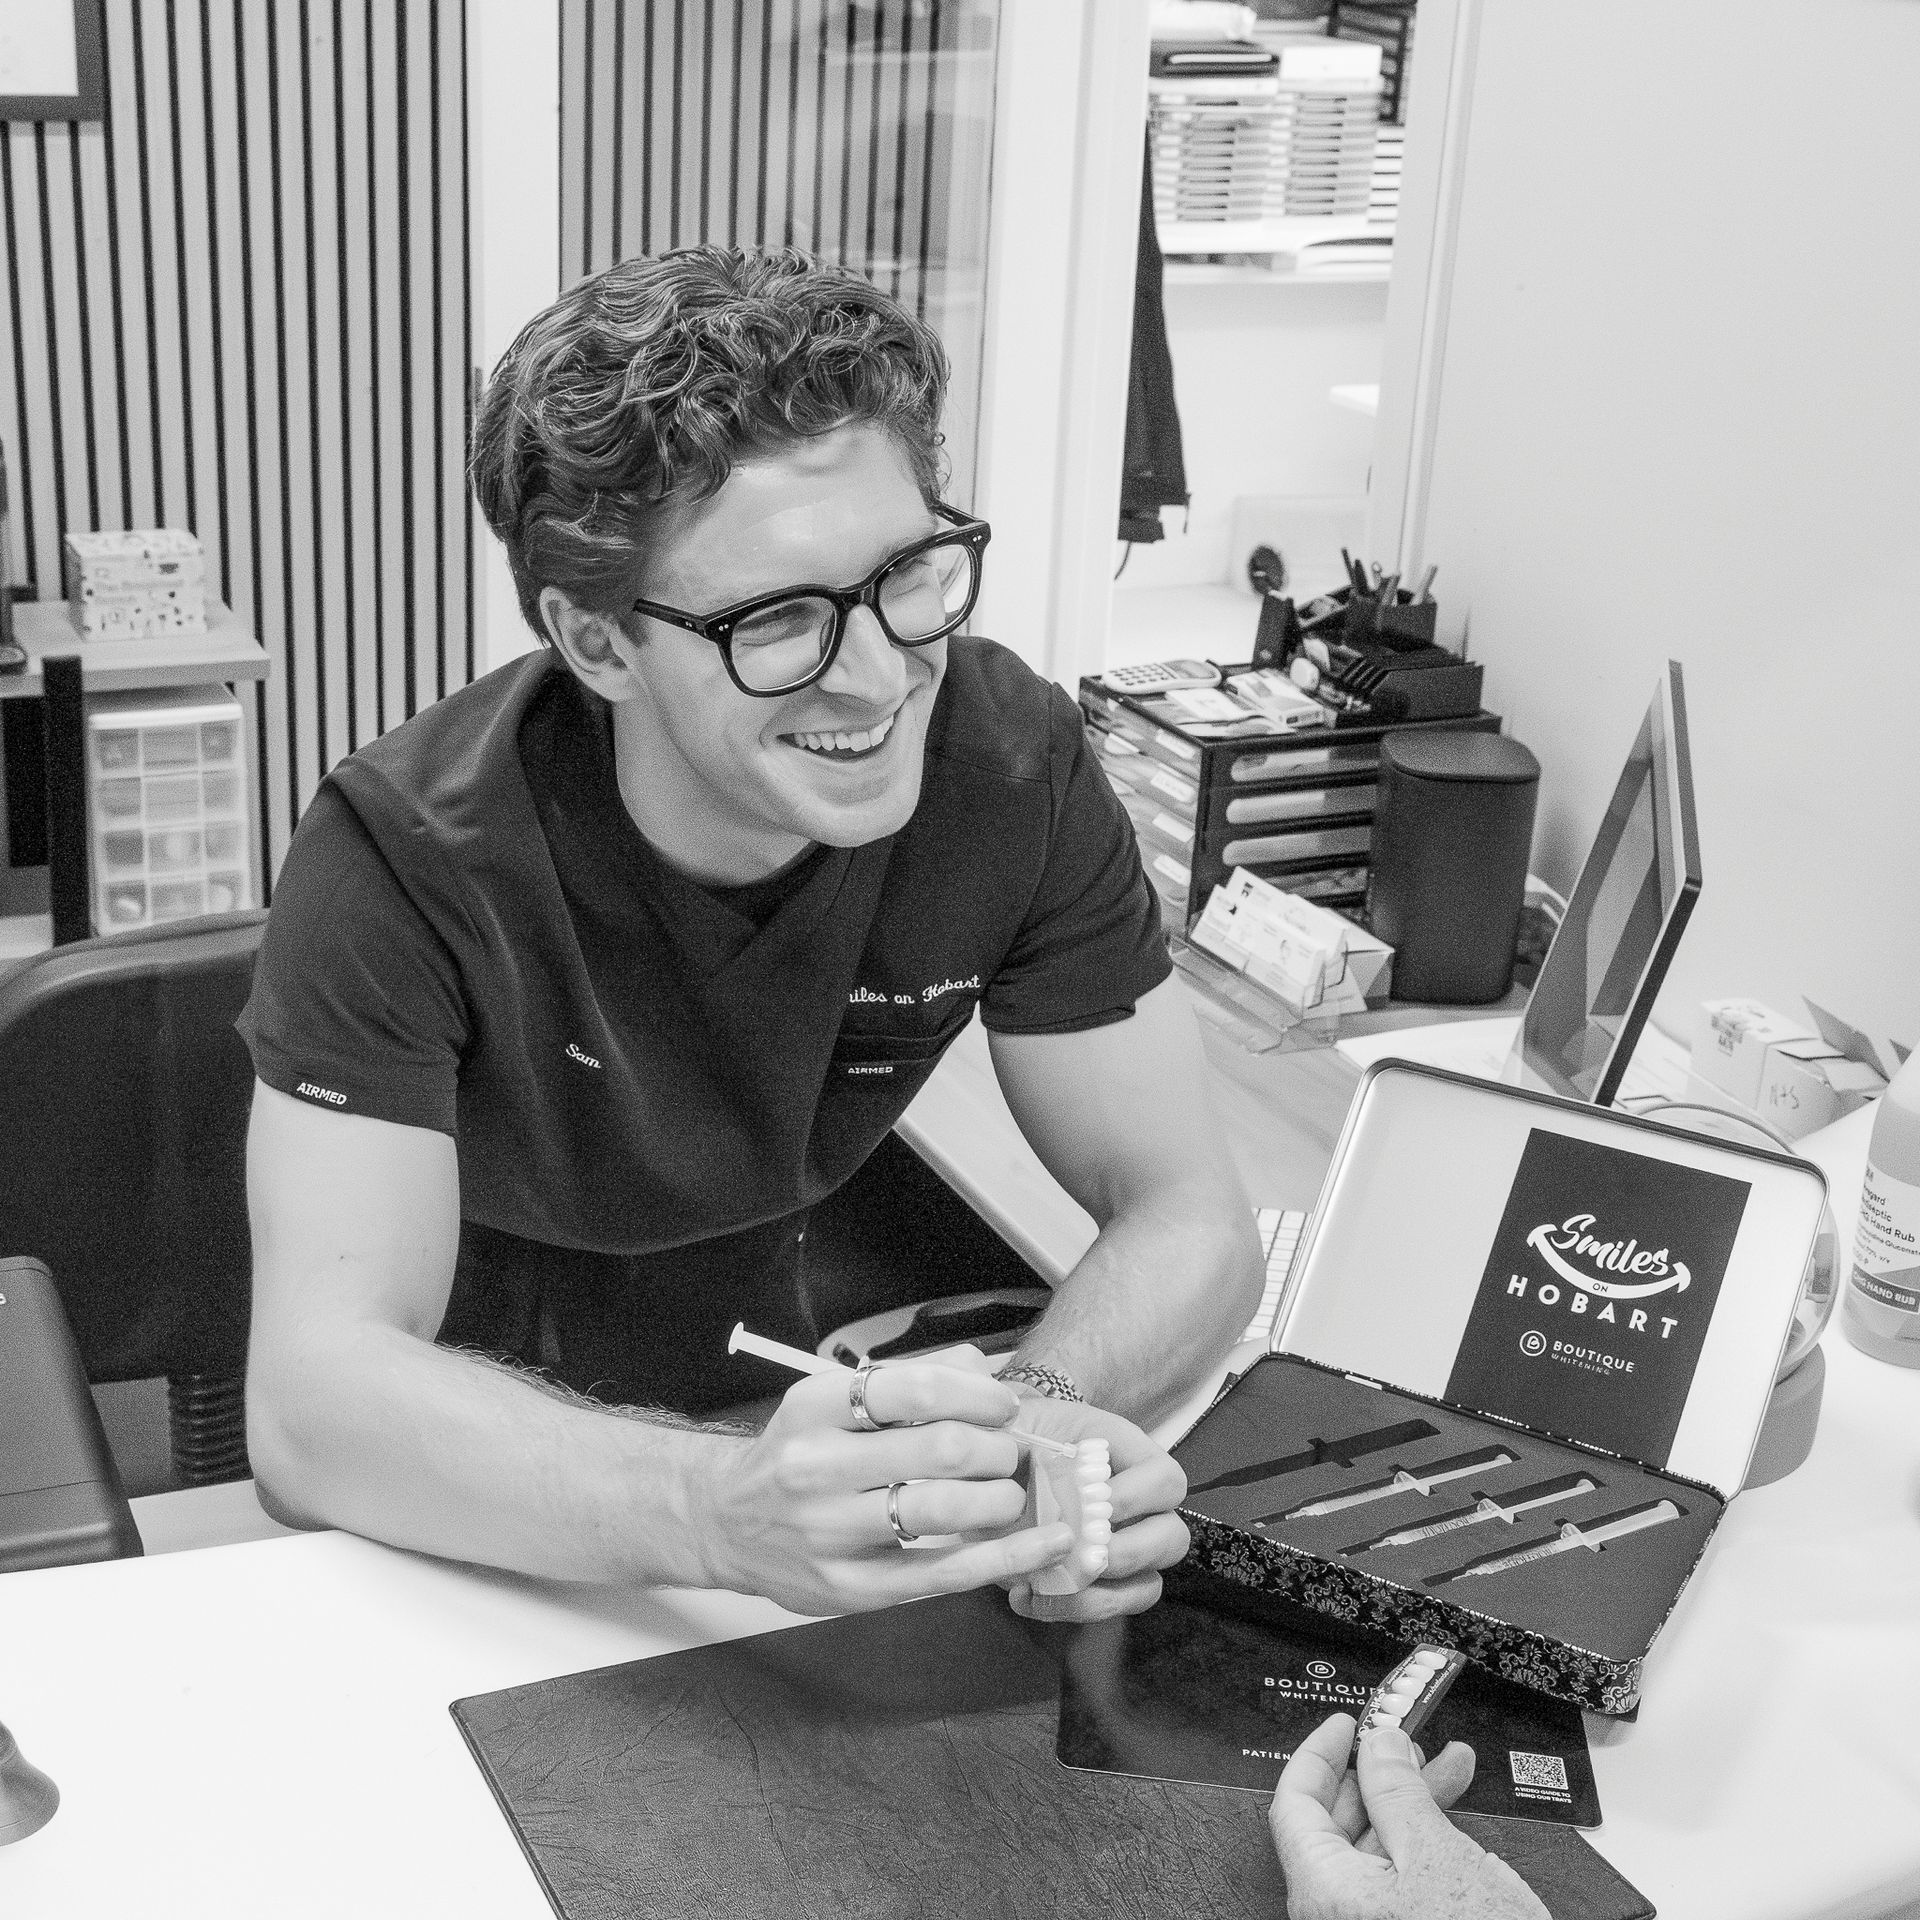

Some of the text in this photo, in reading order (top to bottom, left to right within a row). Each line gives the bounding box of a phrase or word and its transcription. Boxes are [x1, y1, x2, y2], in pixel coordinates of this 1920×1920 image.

[849, 974, 981, 1004] iles on Hobart
[566, 1043, 601, 1069] Sam
[848, 1066, 893, 1075] AIRMED
[297, 1082, 347, 1105] AIRMED
[1550, 1213, 1670, 1276] Smiles
[1894, 1229, 1916, 1243] Rub
[1592, 1282, 1609, 1293] ON
[1866, 1281, 1894, 1299] HAND
[1894, 1293, 1916, 1305] RUB
[1506, 1274, 1679, 1339] HOBART
[1551, 1352, 1611, 1375] WHITENING
[1552, 1340, 1636, 1373] BOUTIQUE
[1279, 1691, 1366, 1706] WHITENING
[1242, 1749, 1292, 1761] PATIEN
